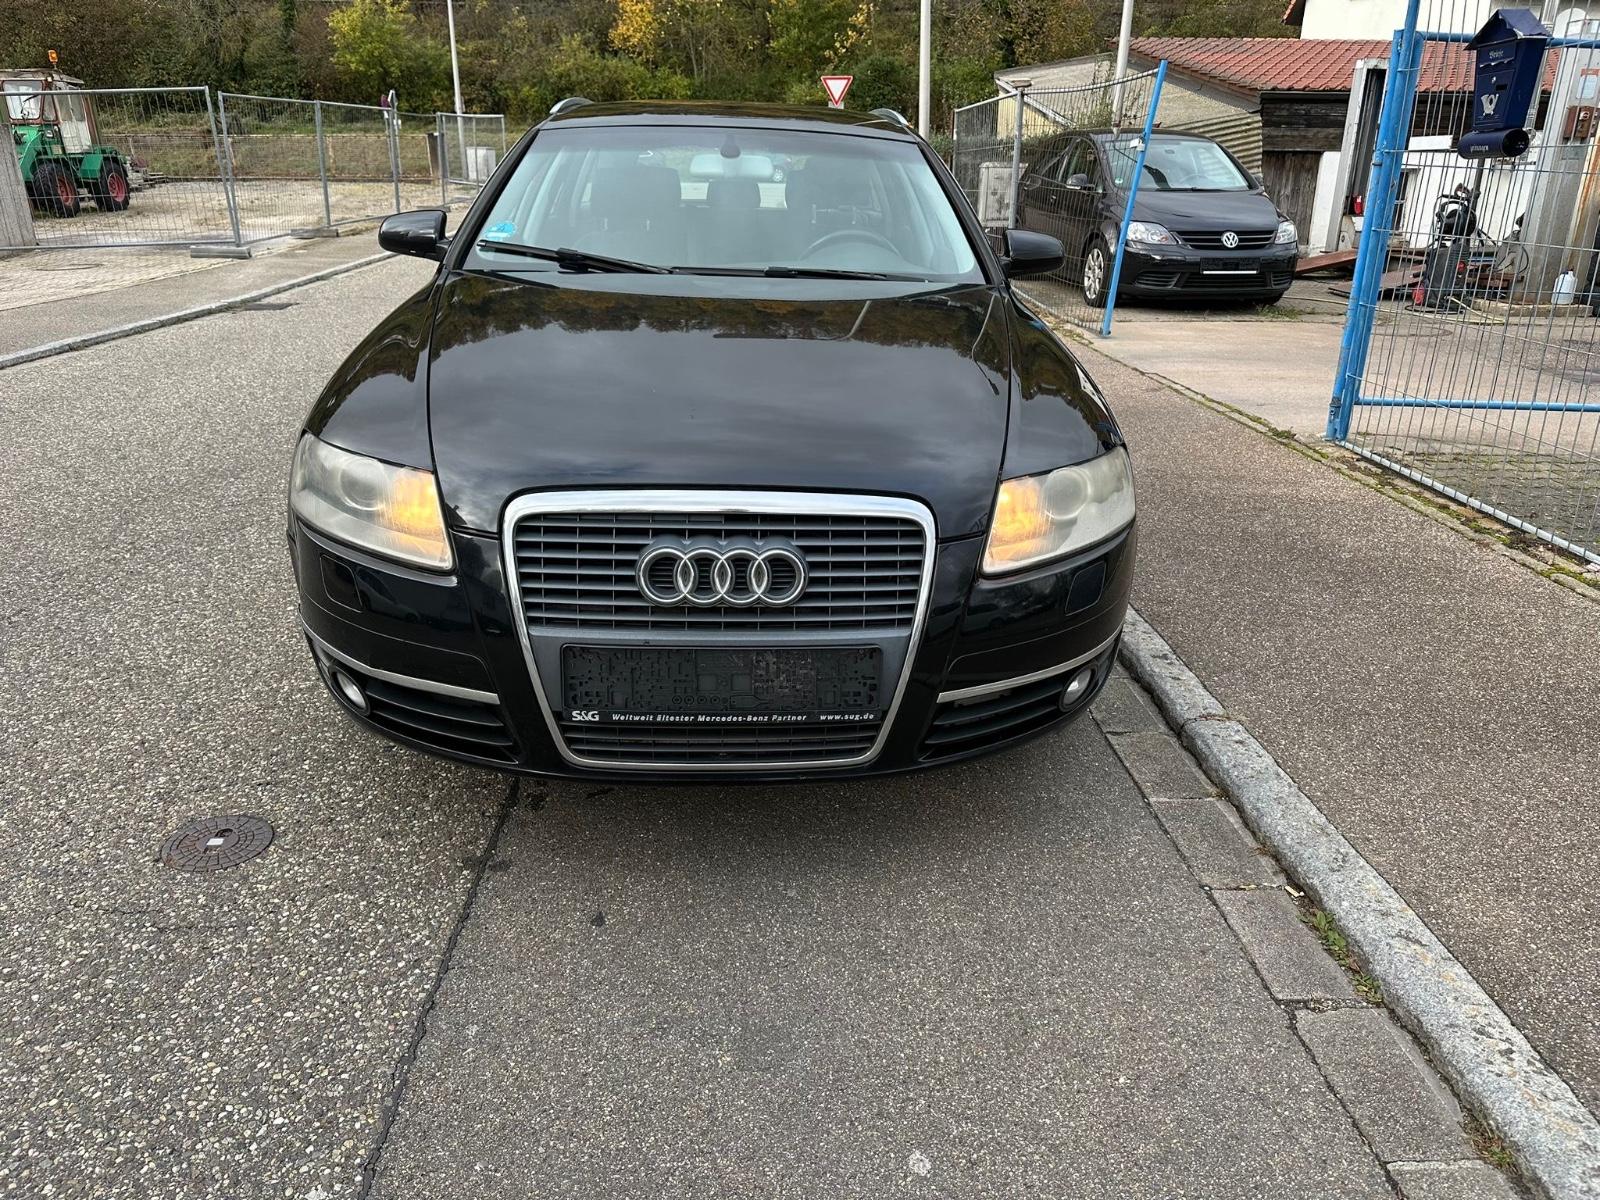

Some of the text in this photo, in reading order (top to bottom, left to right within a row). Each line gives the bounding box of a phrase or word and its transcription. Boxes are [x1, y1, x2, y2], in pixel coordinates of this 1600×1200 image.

[571, 710, 600, 721] S&G
[612, 713, 654, 721] Weltweit
[697, 714, 769, 722] Mercedes-Benz
[772, 714, 807, 722] Partner
[819, 713, 875, 722] www.sug.de
